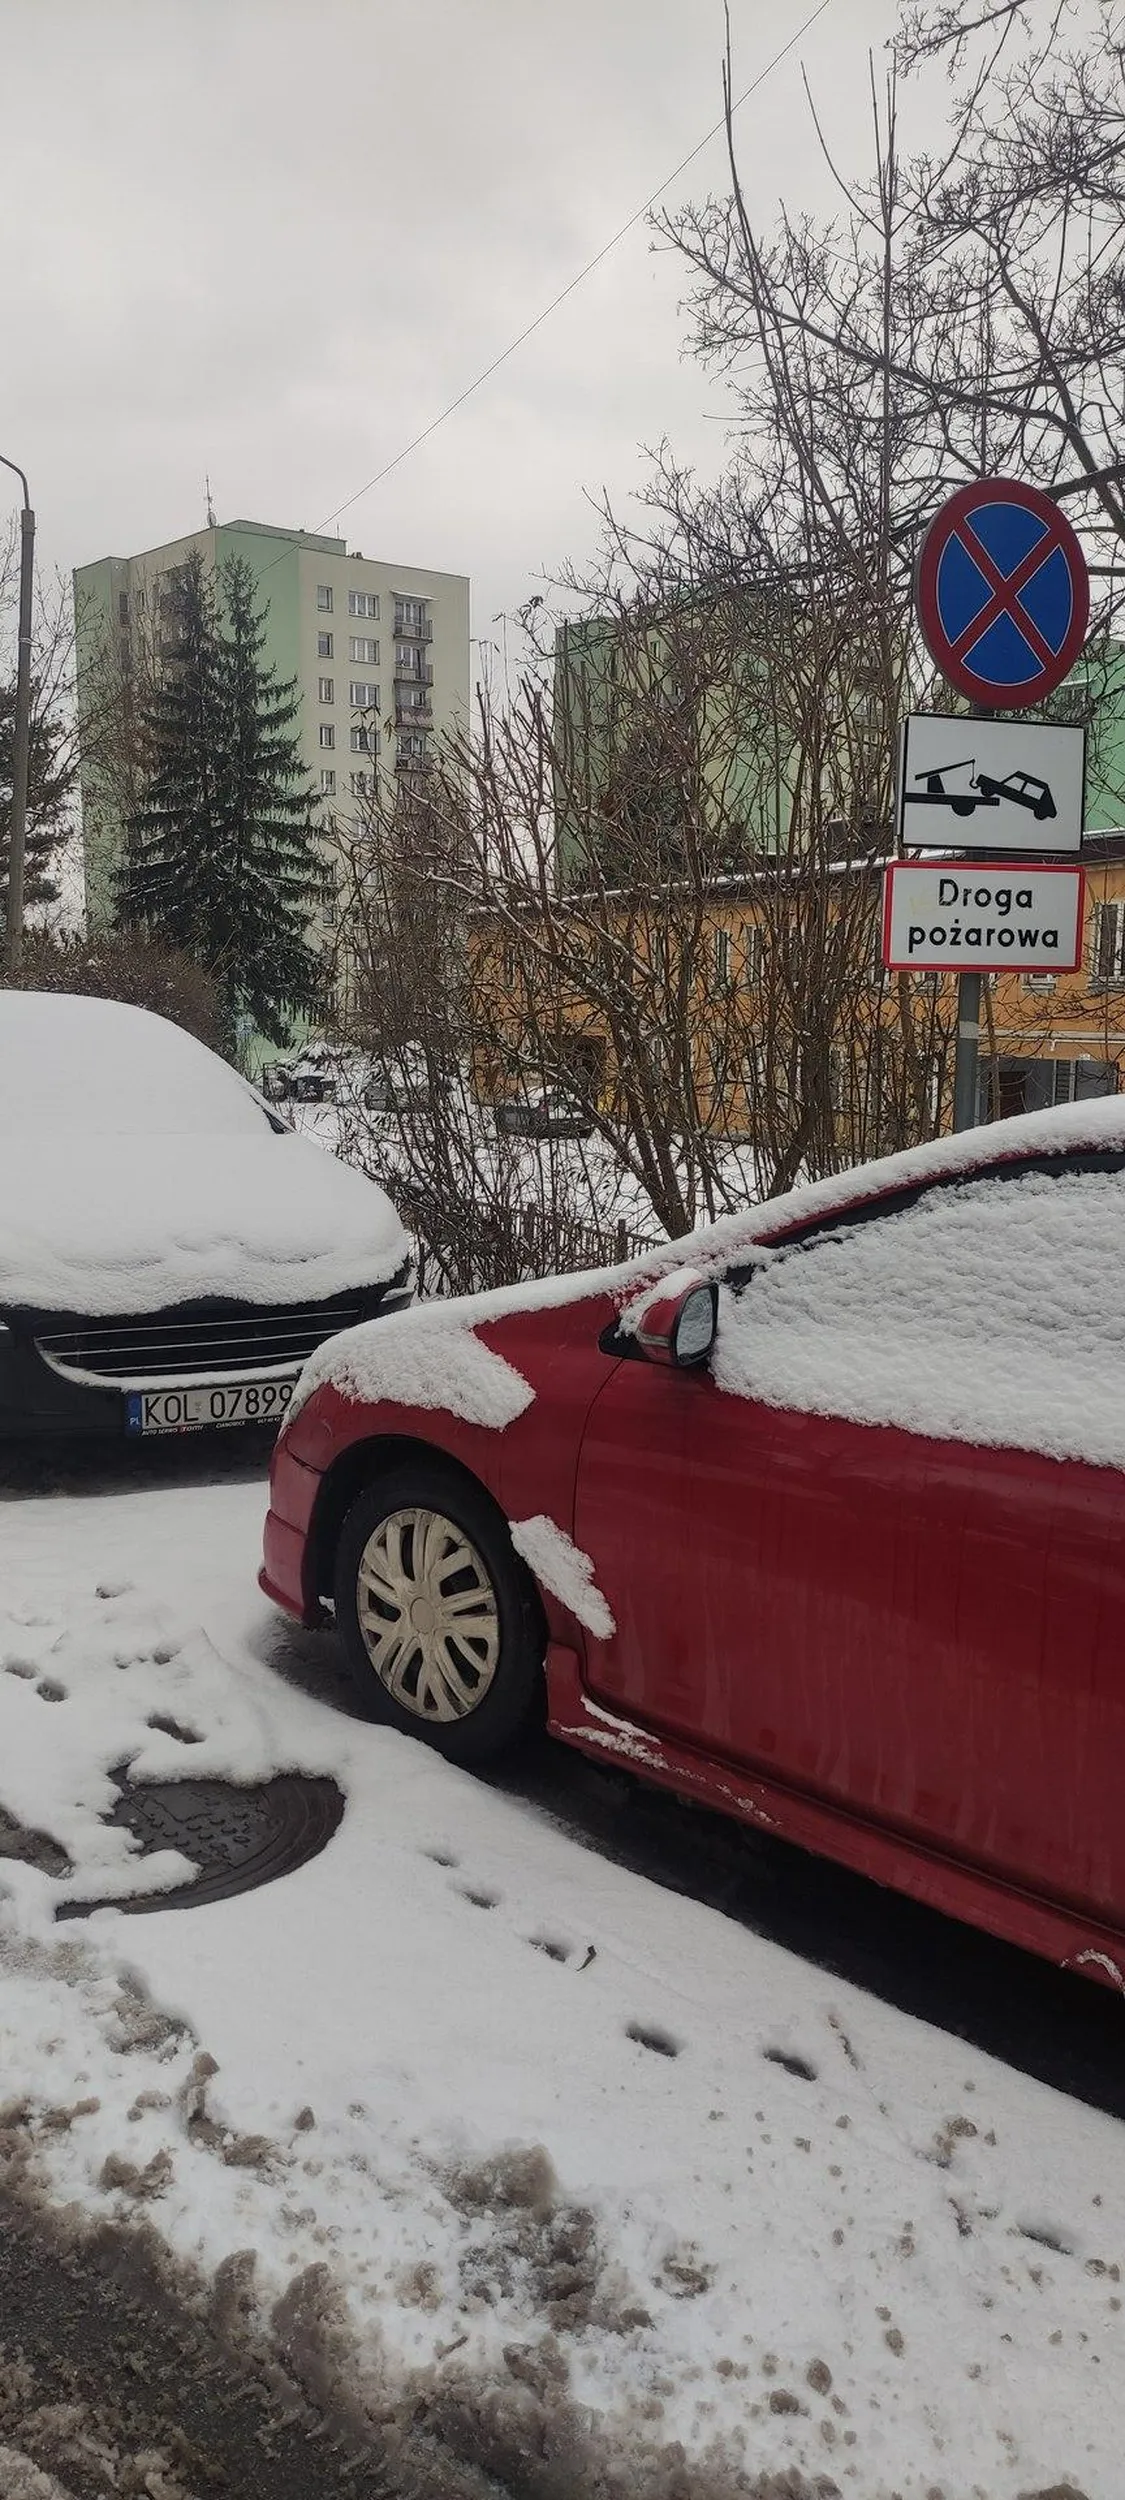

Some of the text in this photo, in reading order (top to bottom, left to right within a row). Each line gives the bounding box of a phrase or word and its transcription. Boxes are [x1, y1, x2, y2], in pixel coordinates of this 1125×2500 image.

[938, 878, 1033, 916] Droga
[908, 918, 1059, 954] pożarowa
[143, 1384, 293, 1427] KOL 07899
